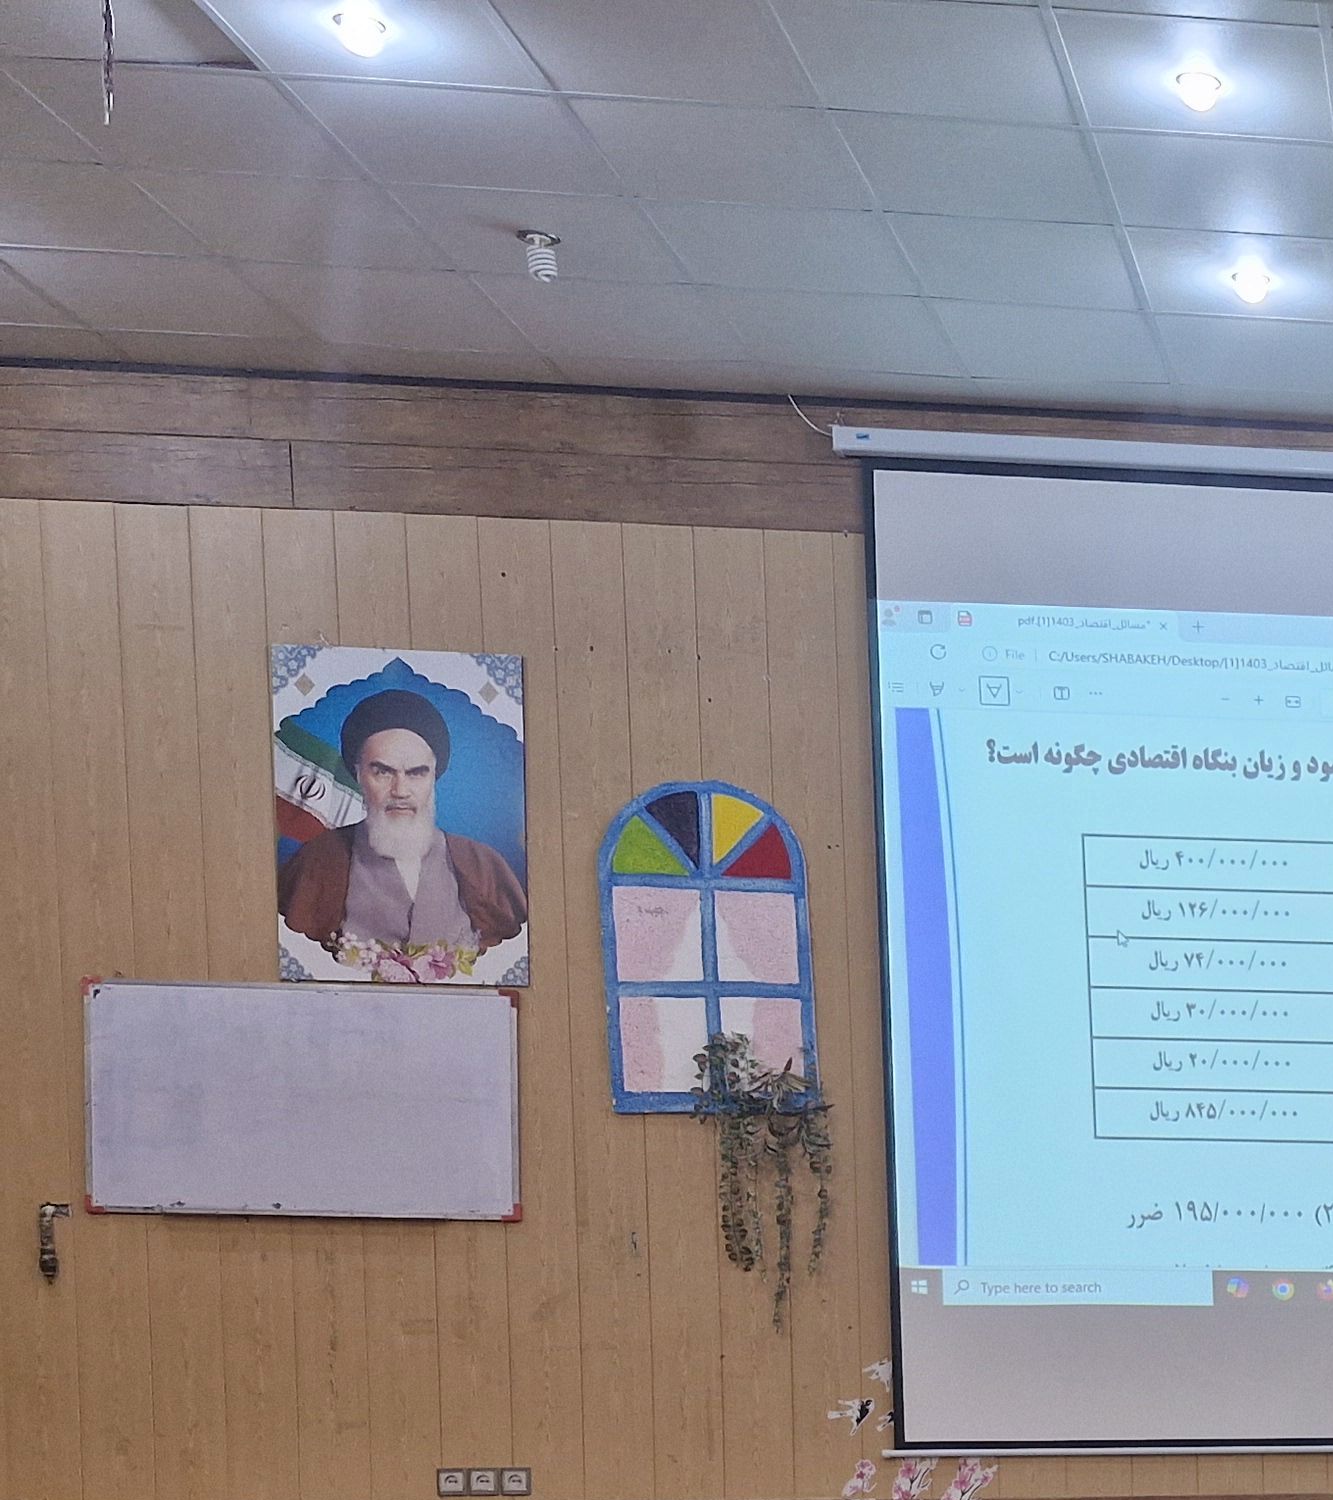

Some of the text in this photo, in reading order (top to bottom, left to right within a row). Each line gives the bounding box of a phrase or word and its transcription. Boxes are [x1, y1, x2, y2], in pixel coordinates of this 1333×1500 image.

[1005, 648, 1025, 661] File
[1043, 741, 1103, 776] چگونه
[1107, 744, 1188, 776] اقتصادی
[1192, 746, 1238, 778] بنگاه
[1242, 749, 1286, 781] زیان
[1290, 759, 1302, 782] و
[1139, 849, 1170, 871] ریال
[1141, 899, 1172, 922] ریال
[1148, 950, 1179, 972] ریال
[1150, 1000, 1181, 1023] ریال
[1152, 1050, 1183, 1073] ریال
[1149, 1100, 1180, 1123] ریال
[1126, 1202, 1164, 1229] ضرر
[980, 1281, 1102, 1297] Type here to search
